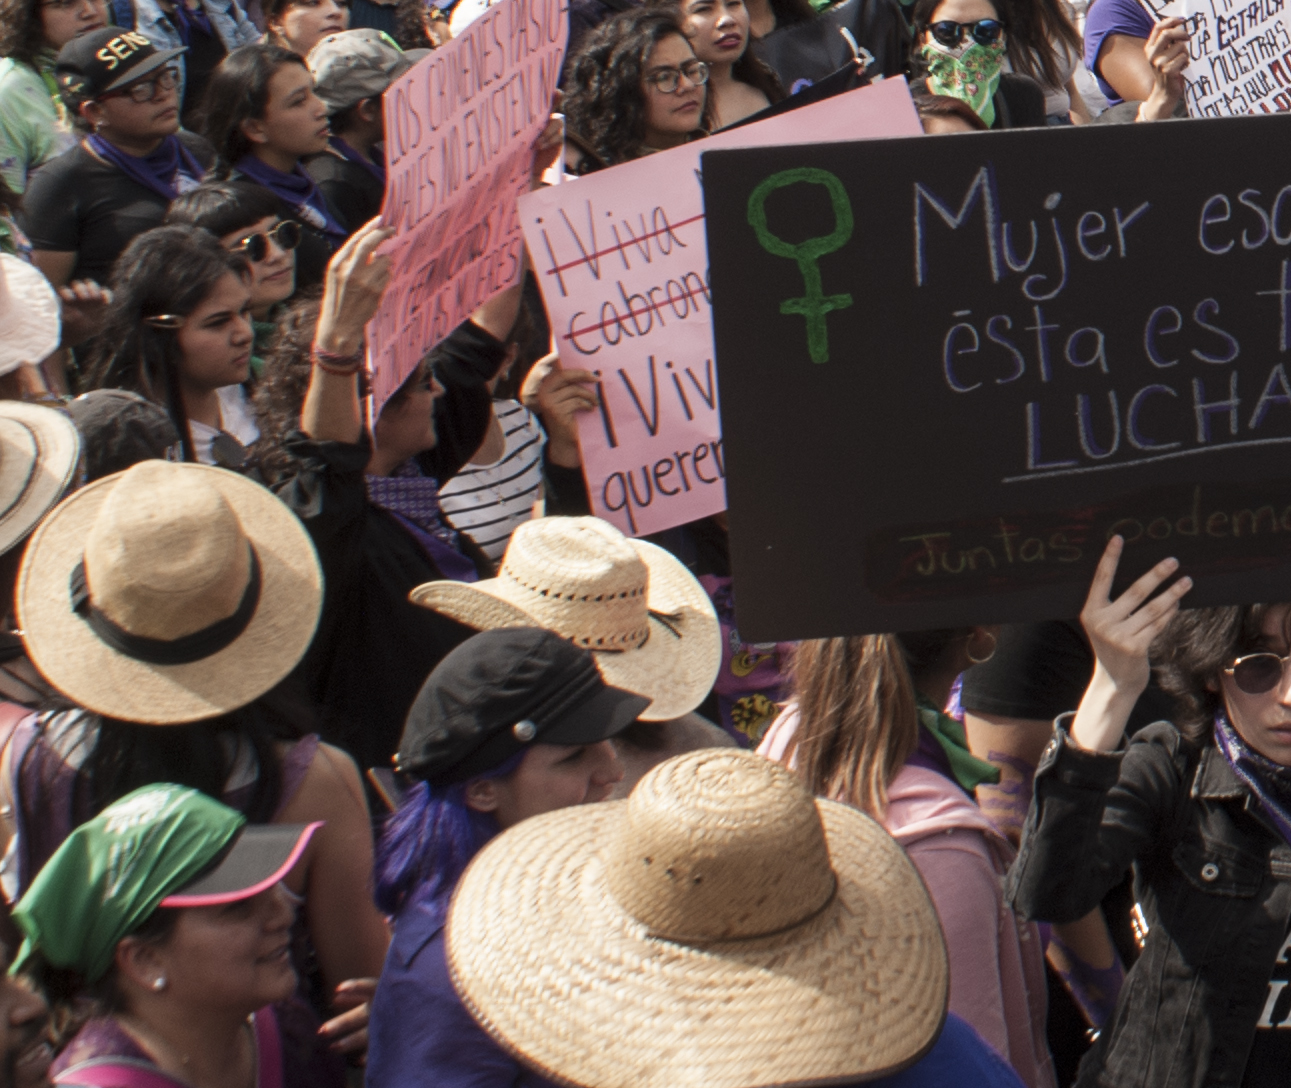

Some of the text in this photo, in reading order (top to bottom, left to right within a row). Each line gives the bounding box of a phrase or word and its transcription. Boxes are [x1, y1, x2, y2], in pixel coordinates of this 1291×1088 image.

[387, 10, 507, 166] LOS CRIMENES
[1243, 66, 1277, 104] QUE
[535, 198, 689, 299] ¡Viva
[912, 165, 1150, 302] Mujer
[1144, 297, 1241, 370] es
[897, 527, 1085, 578] Juntas
